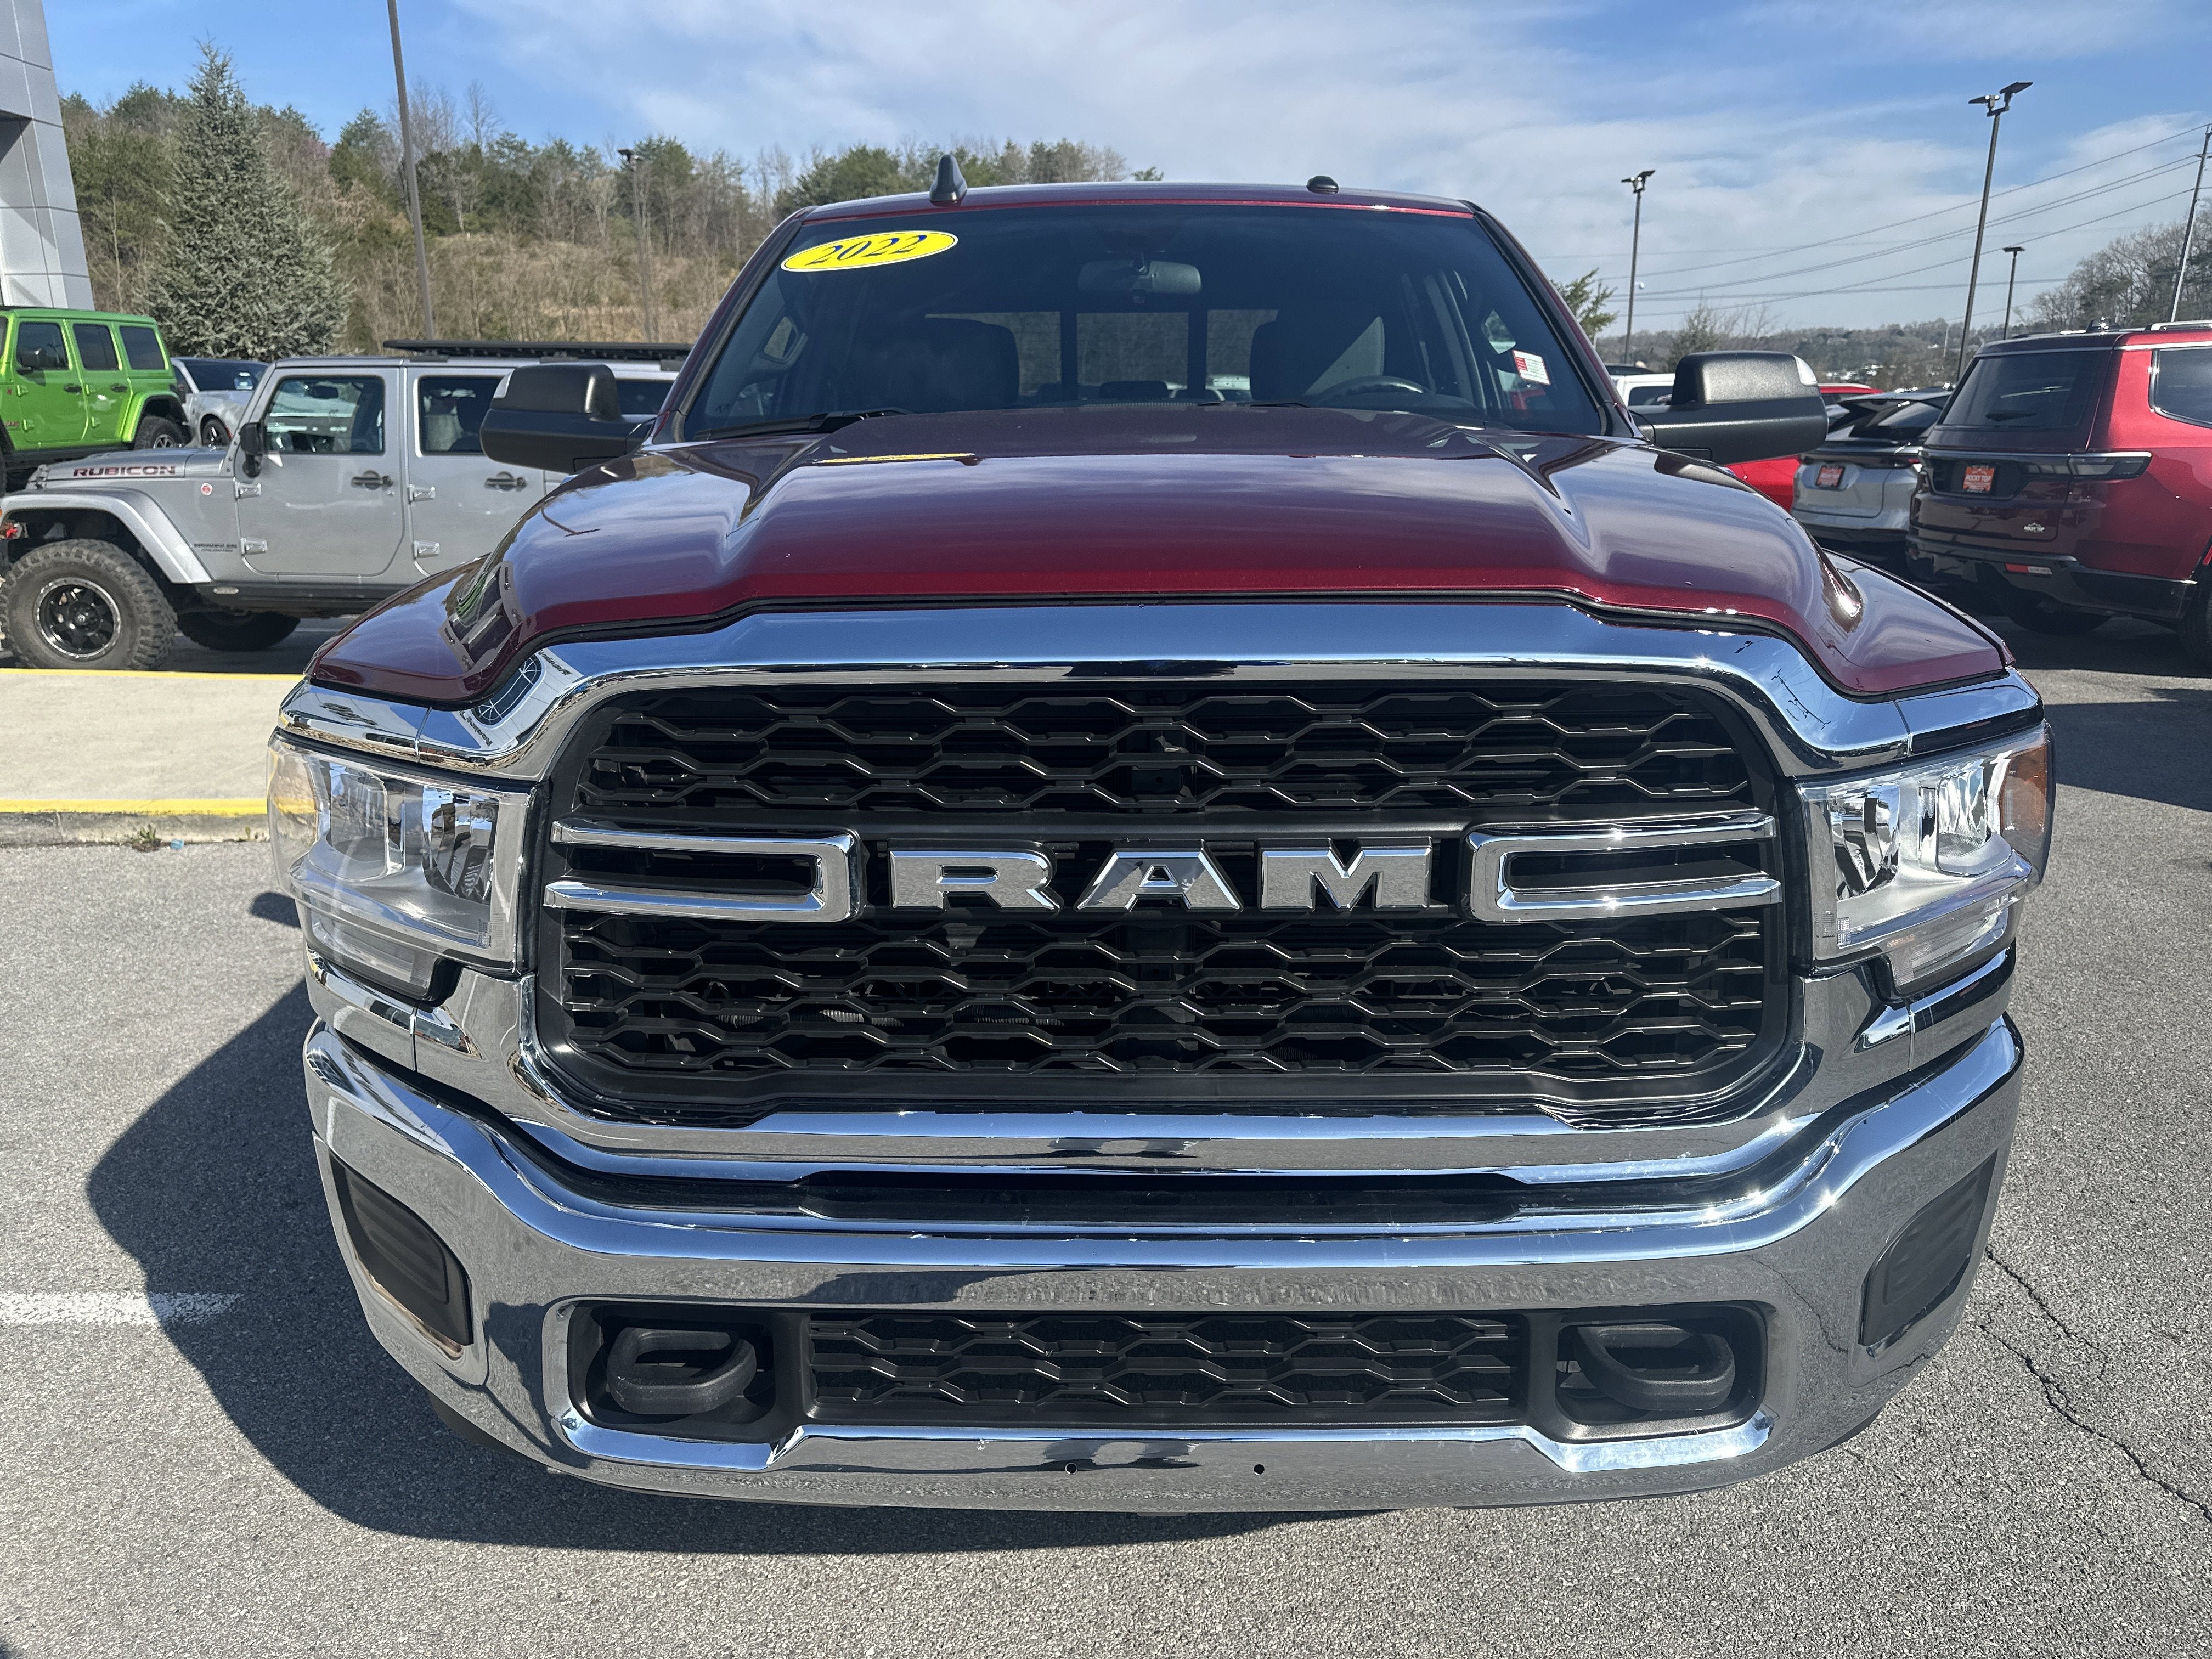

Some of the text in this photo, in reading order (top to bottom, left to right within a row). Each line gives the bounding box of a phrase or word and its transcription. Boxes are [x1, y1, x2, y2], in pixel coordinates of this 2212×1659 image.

[804, 234, 927, 267] 2022
[73, 466, 176, 476] RUBICON
[890, 846, 1431, 912] RAM
